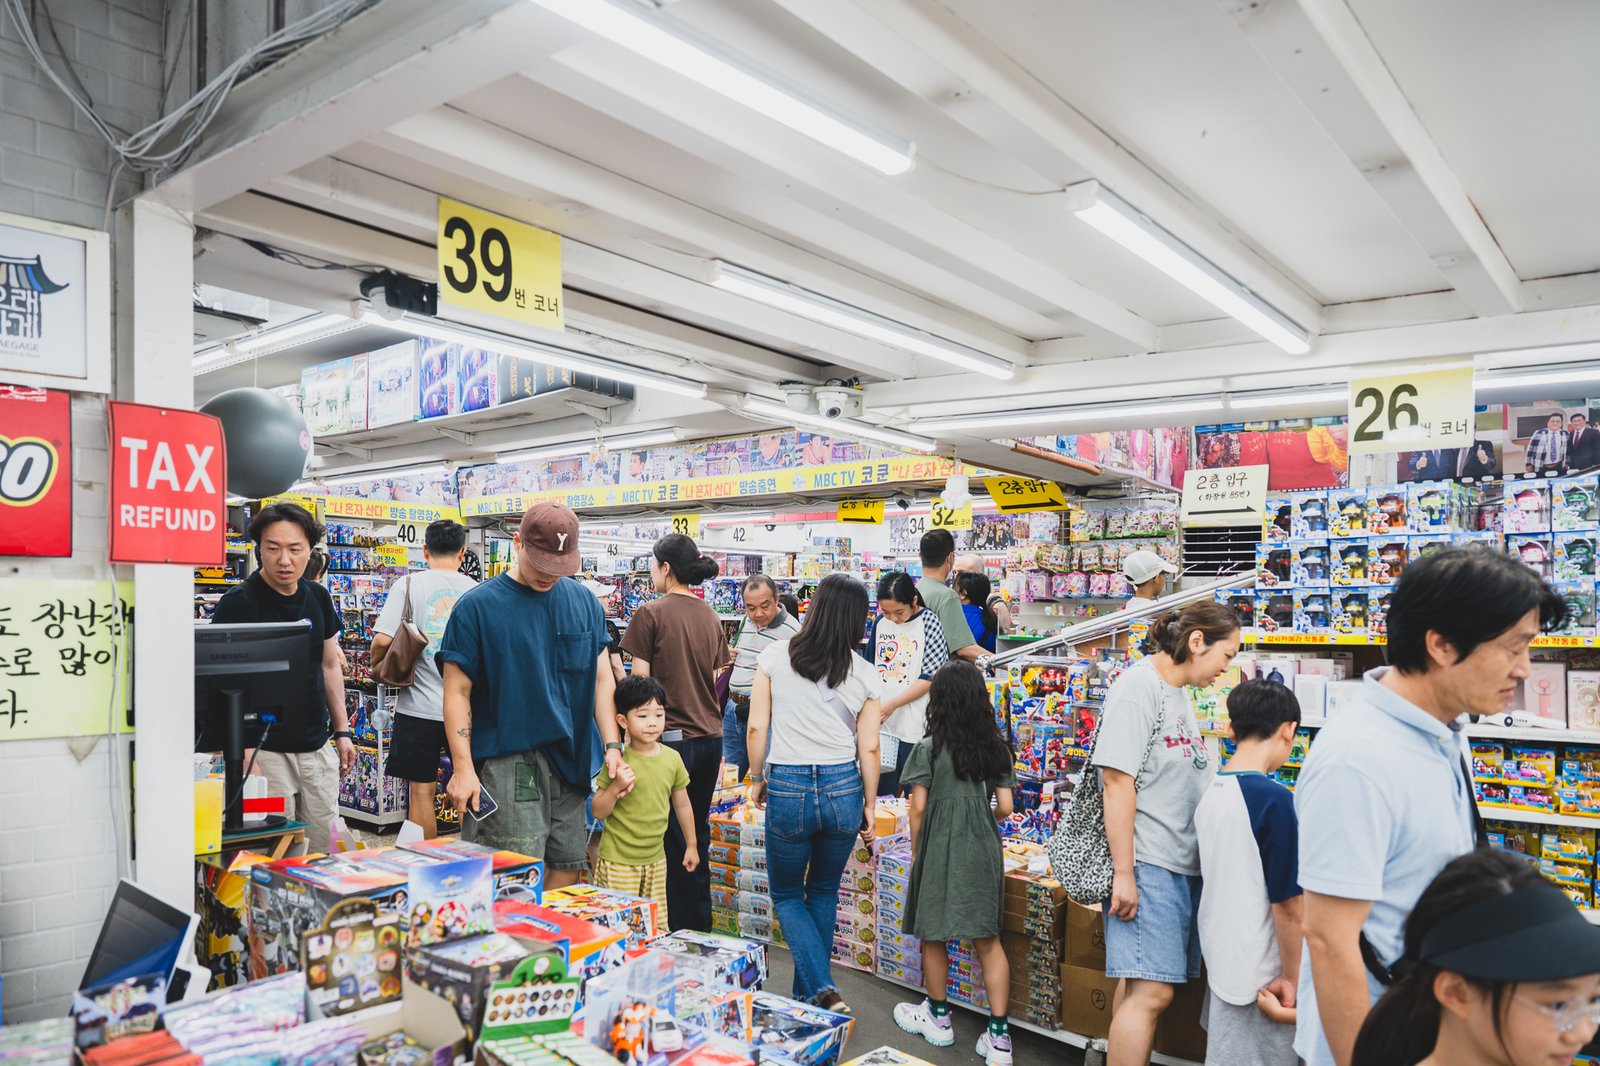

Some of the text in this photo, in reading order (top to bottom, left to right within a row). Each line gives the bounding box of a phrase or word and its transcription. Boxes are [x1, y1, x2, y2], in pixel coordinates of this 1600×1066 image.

[534, 294, 559, 317] 코너
[1353, 383, 1420, 443] 26
[1440, 418, 1468, 436] 코너
[120, 437, 216, 494] TAX
[813, 472, 837, 489] MBC
[841, 470, 856, 485] TV
[912, 462, 937, 478] 혼자
[621, 489, 640, 503] MBC
[642, 488, 654, 502] TV
[695, 482, 713, 498] 혼자
[739, 477, 777, 495] 방송출연
[998, 480, 1025, 496] 2층
[1196, 471, 1248, 490] 2층 입구
[345, 502, 364, 516] 혼자
[389, 506, 407, 519] 방송
[477, 502, 493, 514] MBC
[494, 500, 503, 513] TV
[932, 501, 955, 527] 32
[120, 504, 216, 532] REFUND
[672, 517, 689, 536] 33
[909, 517, 925, 534] 34
[397, 523, 416, 544] 40
[556, 532, 569, 551] Y
[733, 527, 746, 542] 42
[606, 543, 618, 556] 43
[31, 597, 134, 640] 장난감
[58, 640, 119, 678] 많이
